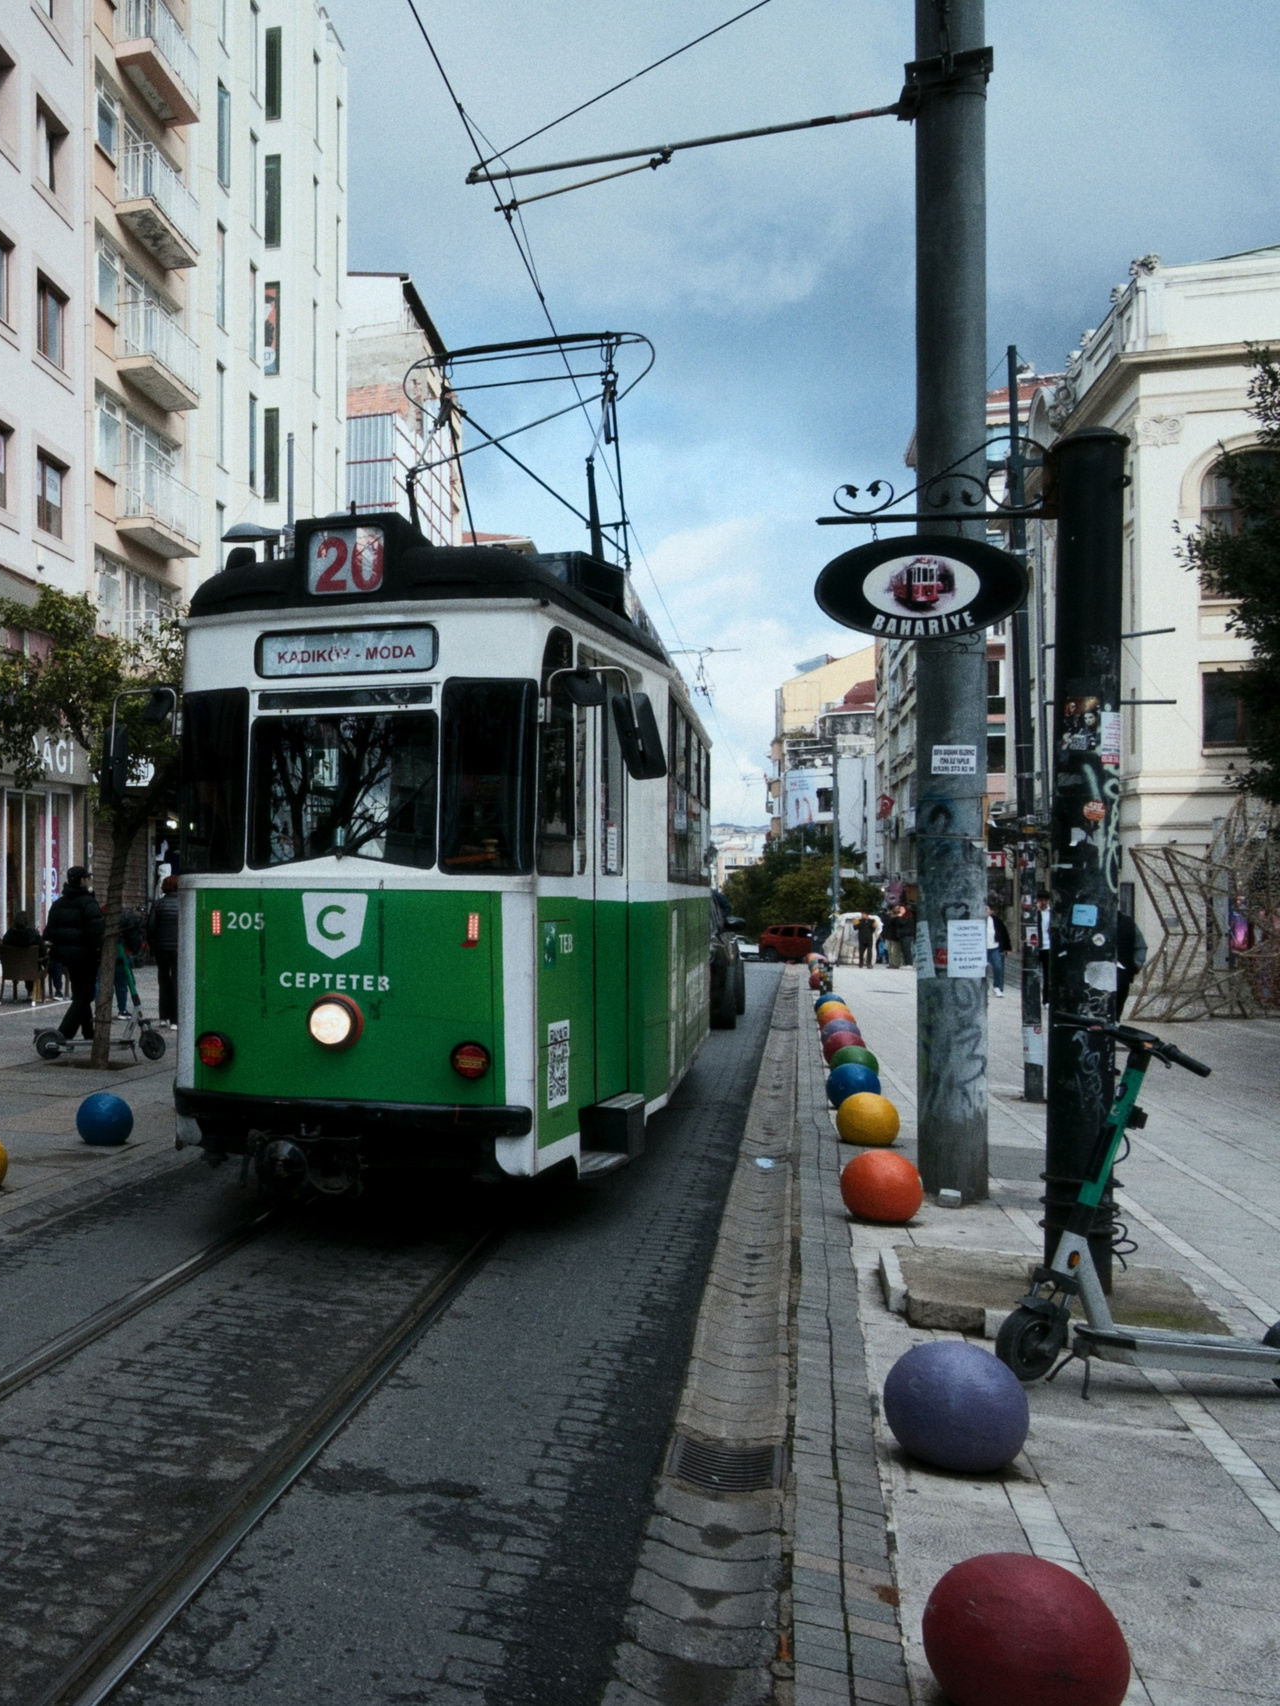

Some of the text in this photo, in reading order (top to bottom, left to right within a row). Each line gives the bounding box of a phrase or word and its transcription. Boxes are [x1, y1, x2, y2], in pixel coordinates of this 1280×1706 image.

[315, 534, 384, 592] 20
[871, 611, 976, 636] BAHARİYE
[277, 646, 351, 664] KADIKÖY
[365, 644, 416, 661] MODA
[227, 911, 266, 930] 205
[558, 933, 573, 954] TEB
[279, 971, 390, 991] CEPTETEB
